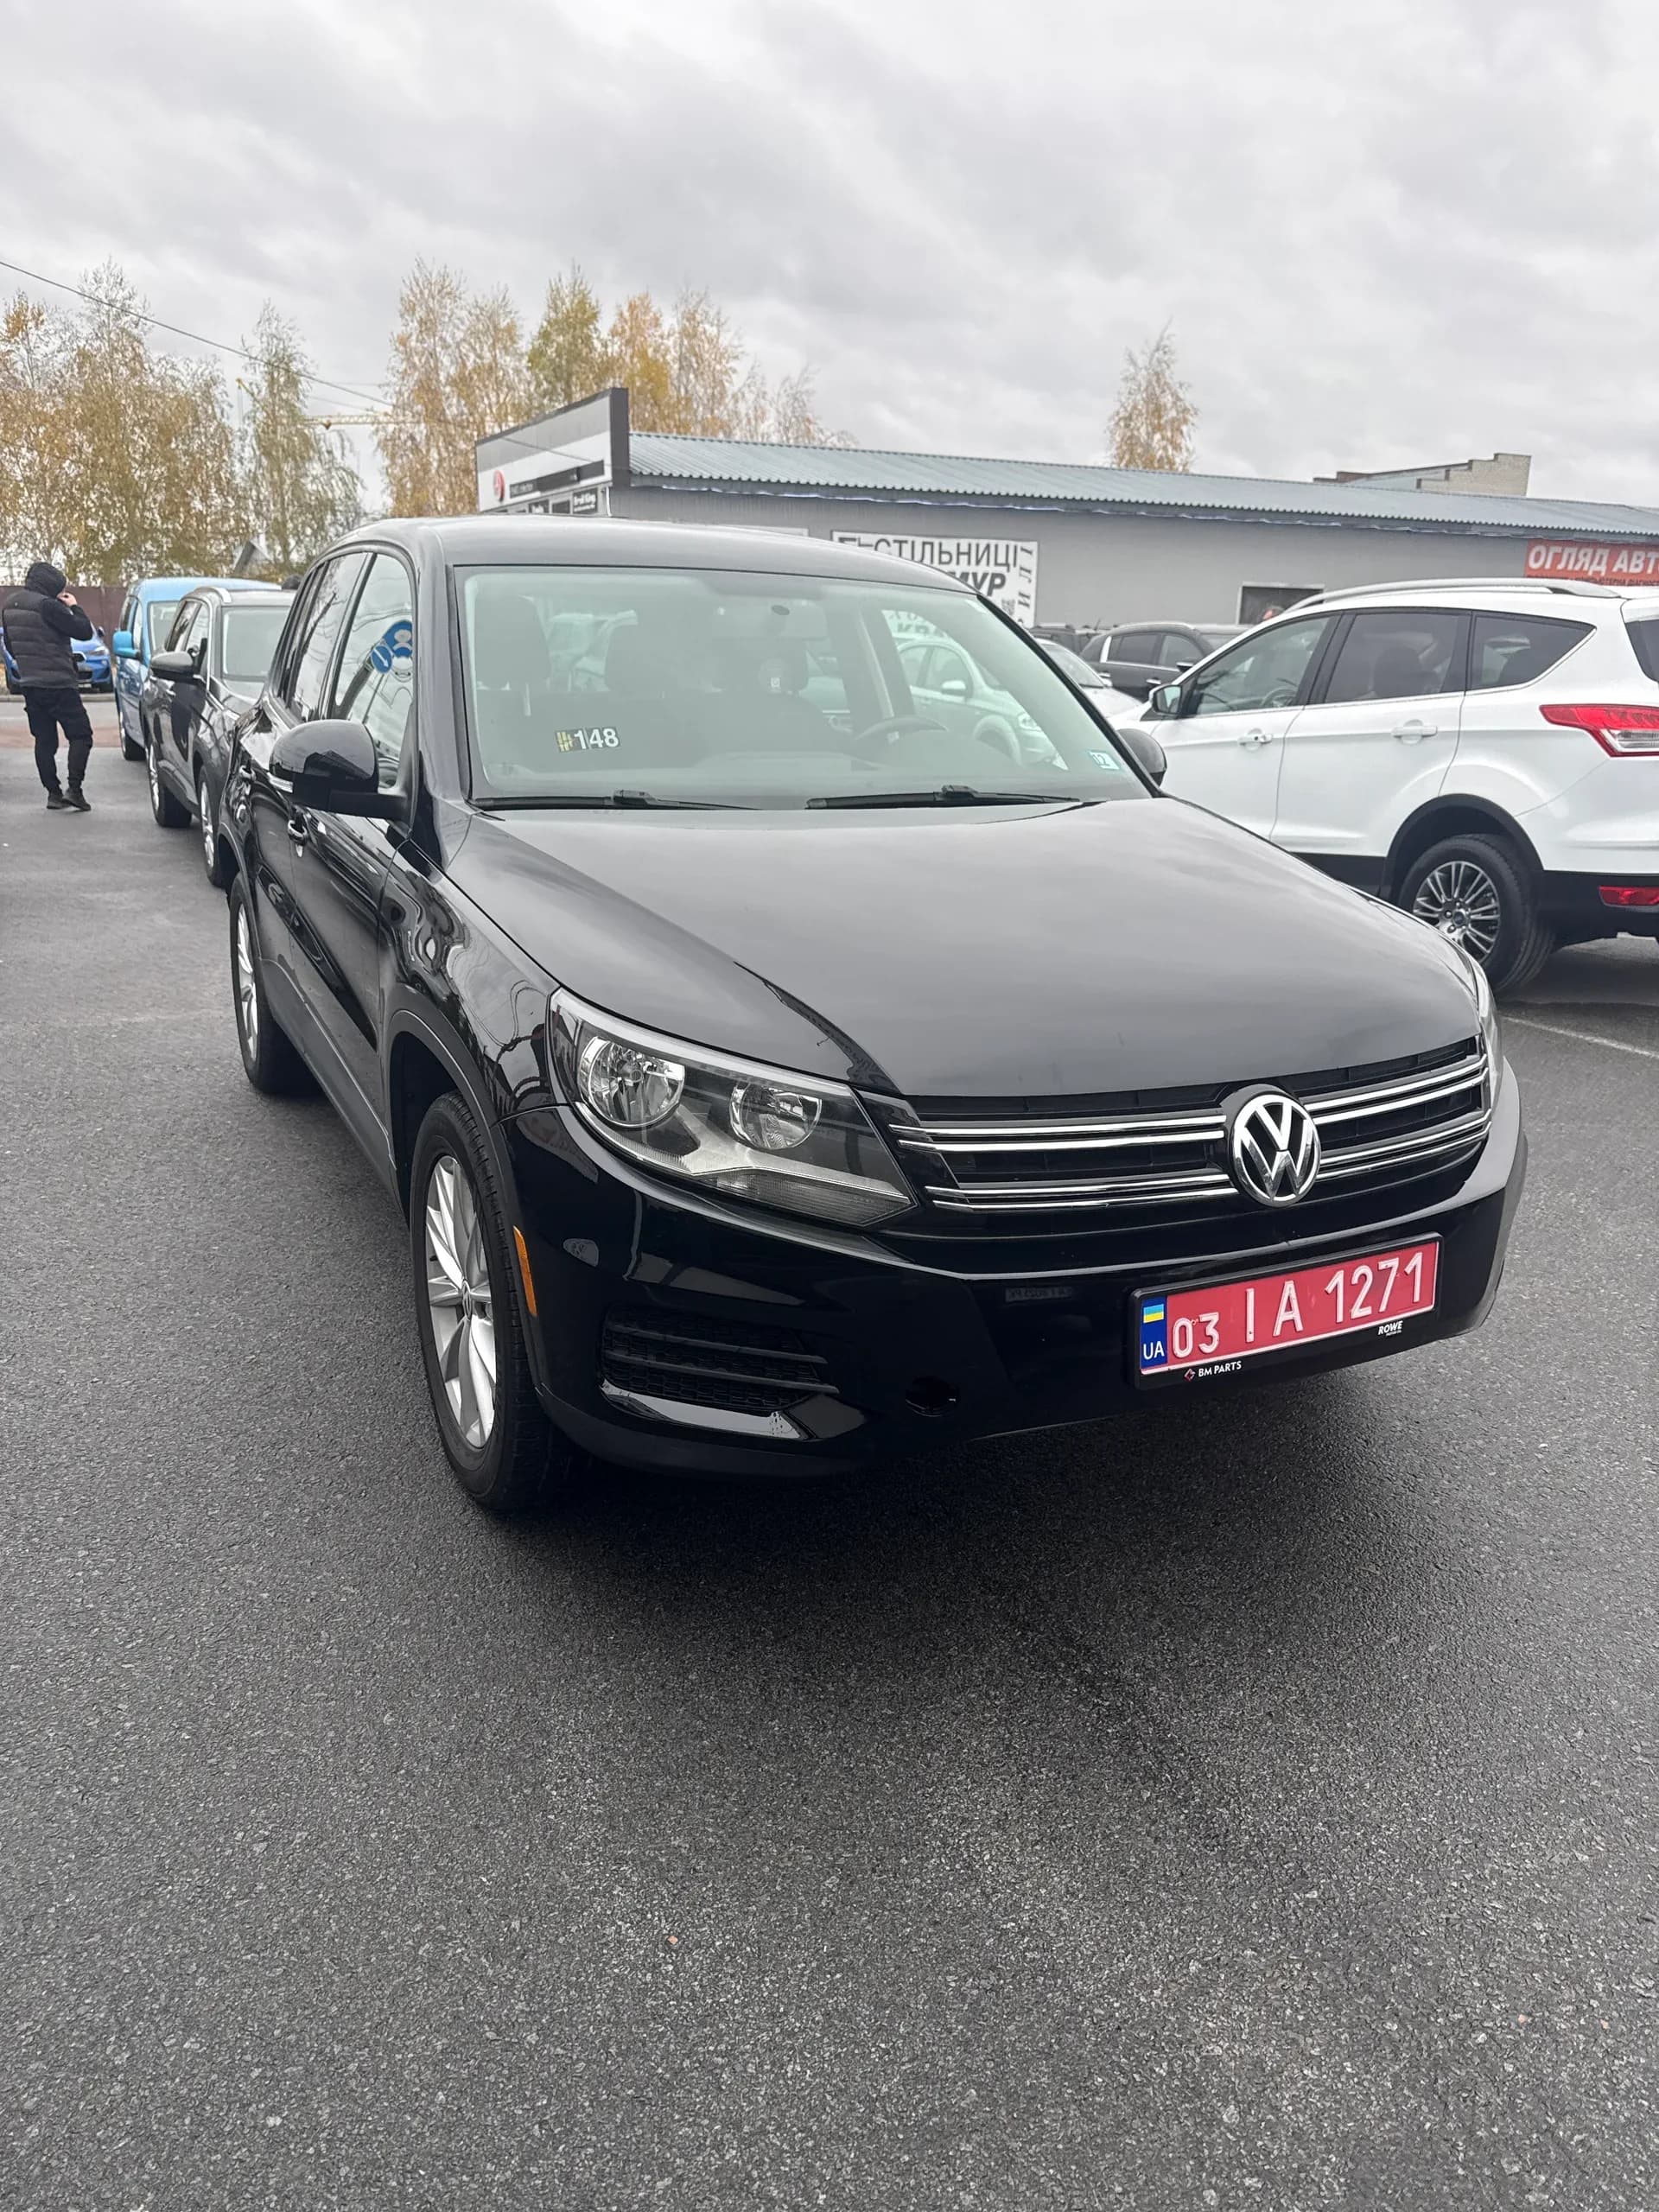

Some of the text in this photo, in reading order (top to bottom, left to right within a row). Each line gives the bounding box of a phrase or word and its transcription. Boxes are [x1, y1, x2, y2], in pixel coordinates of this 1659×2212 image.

[1528, 545, 1659, 577] ОГЛЯД АВТ
[1173, 1312, 1219, 1358] 03
[1325, 1252, 1423, 1323] 1271
[1377, 1320, 1403, 1335] ROWE
[1143, 1340, 1165, 1360] UA
[1198, 1361, 1242, 1377] BM PARTS
